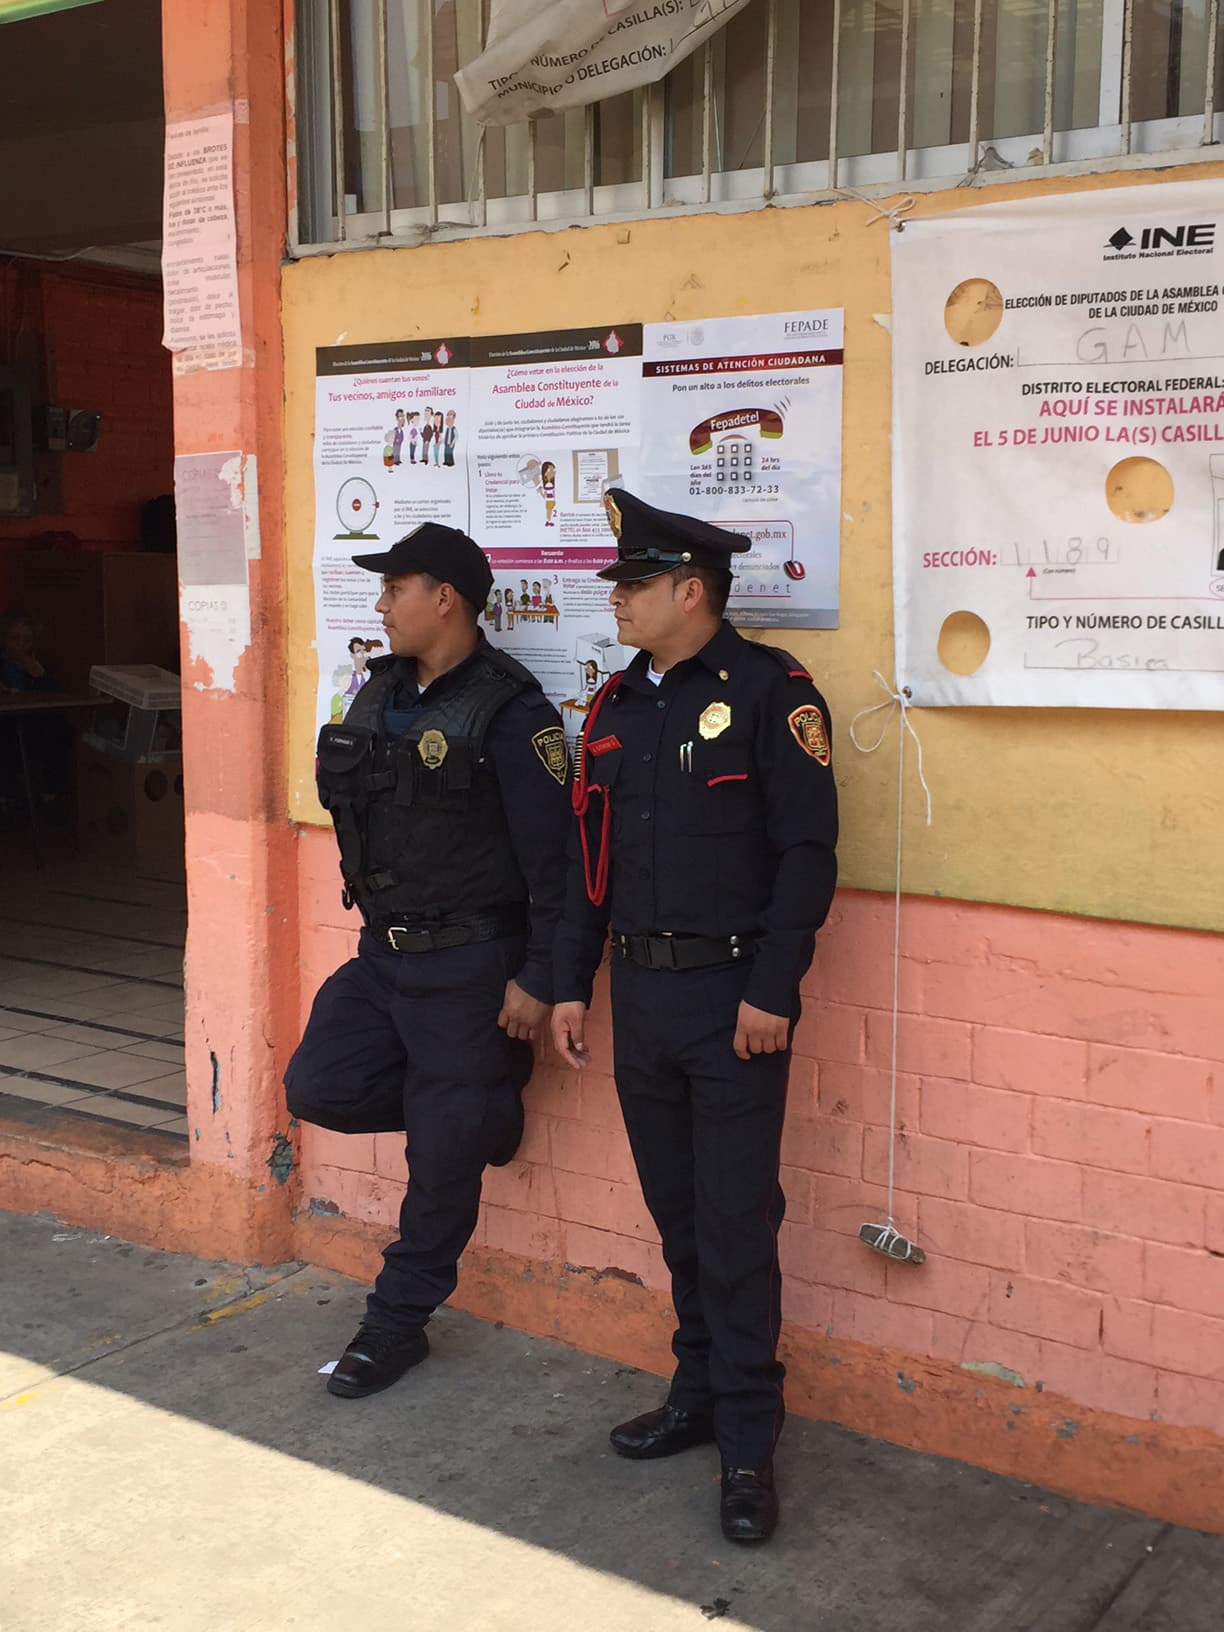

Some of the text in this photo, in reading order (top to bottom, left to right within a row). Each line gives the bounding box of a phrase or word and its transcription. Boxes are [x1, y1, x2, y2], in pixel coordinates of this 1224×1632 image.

[577, 45, 667, 81] DELEGACIÓN:
[1141, 223, 1216, 250] INE
[1103, 247, 1214, 261] Instituto Nacional Electoral
[1005, 295, 1052, 310] ELECCIÓN
[1055, 294, 1068, 307] DE
[1070, 290, 1127, 306] DIPUTADOS
[1130, 289, 1144, 302] DE
[1146, 288, 1160, 301] LA
[1162, 285, 1219, 299] ASAMBLEA
[1089, 300, 1218, 319] DE LA CIUDAD DE MÉXICO
[784, 319, 829, 334] FEPADE
[1076, 319, 1191, 364] GAM
[507, 369, 528, 379] ¿Cómo
[561, 365, 586, 373] elección
[656, 355, 826, 374] SISTEMAS DE ATENCIÓN CIUDADANA
[924, 353, 1014, 375] DELEGACIÓN:
[492, 384, 536, 395] Asamblea
[538, 379, 602, 392] Constituyente
[672, 384, 687, 392] Pon
[700, 382, 715, 390] alto
[723, 380, 735, 389] los
[737, 378, 763, 388] delitos
[765, 377, 810, 387] electorales
[1022, 381, 1082, 396] DISTRITO
[1086, 378, 1162, 394] ELECTORAL
[328, 392, 342, 402] Tus
[343, 391, 375, 401] vecinos,
[376, 389, 406, 401] amigos
[415, 387, 456, 397] familiares
[515, 398, 545, 409] Ciudad
[556, 395, 594, 408] México?
[1039, 396, 1090, 417] AQUÍ
[1094, 399, 1118, 416] SE
[711, 411, 760, 431] Fepadetel
[973, 431, 992, 447] EL
[998, 430, 1008, 445] 5
[1013, 429, 1036, 445] DE
[1040, 425, 1099, 444] JUNIO
[1105, 425, 1157, 445] LA(S)
[689, 485, 780, 495] 01-800-833-72-33
[923, 547, 998, 568] SECCIÓN:
[553, 574, 559, 584] 3
[1026, 616, 1059, 629] TIPO
[1063, 616, 1077, 629] Y
[1077, 613, 1142, 630] NÚMERO
[1147, 616, 1167, 629] DE
